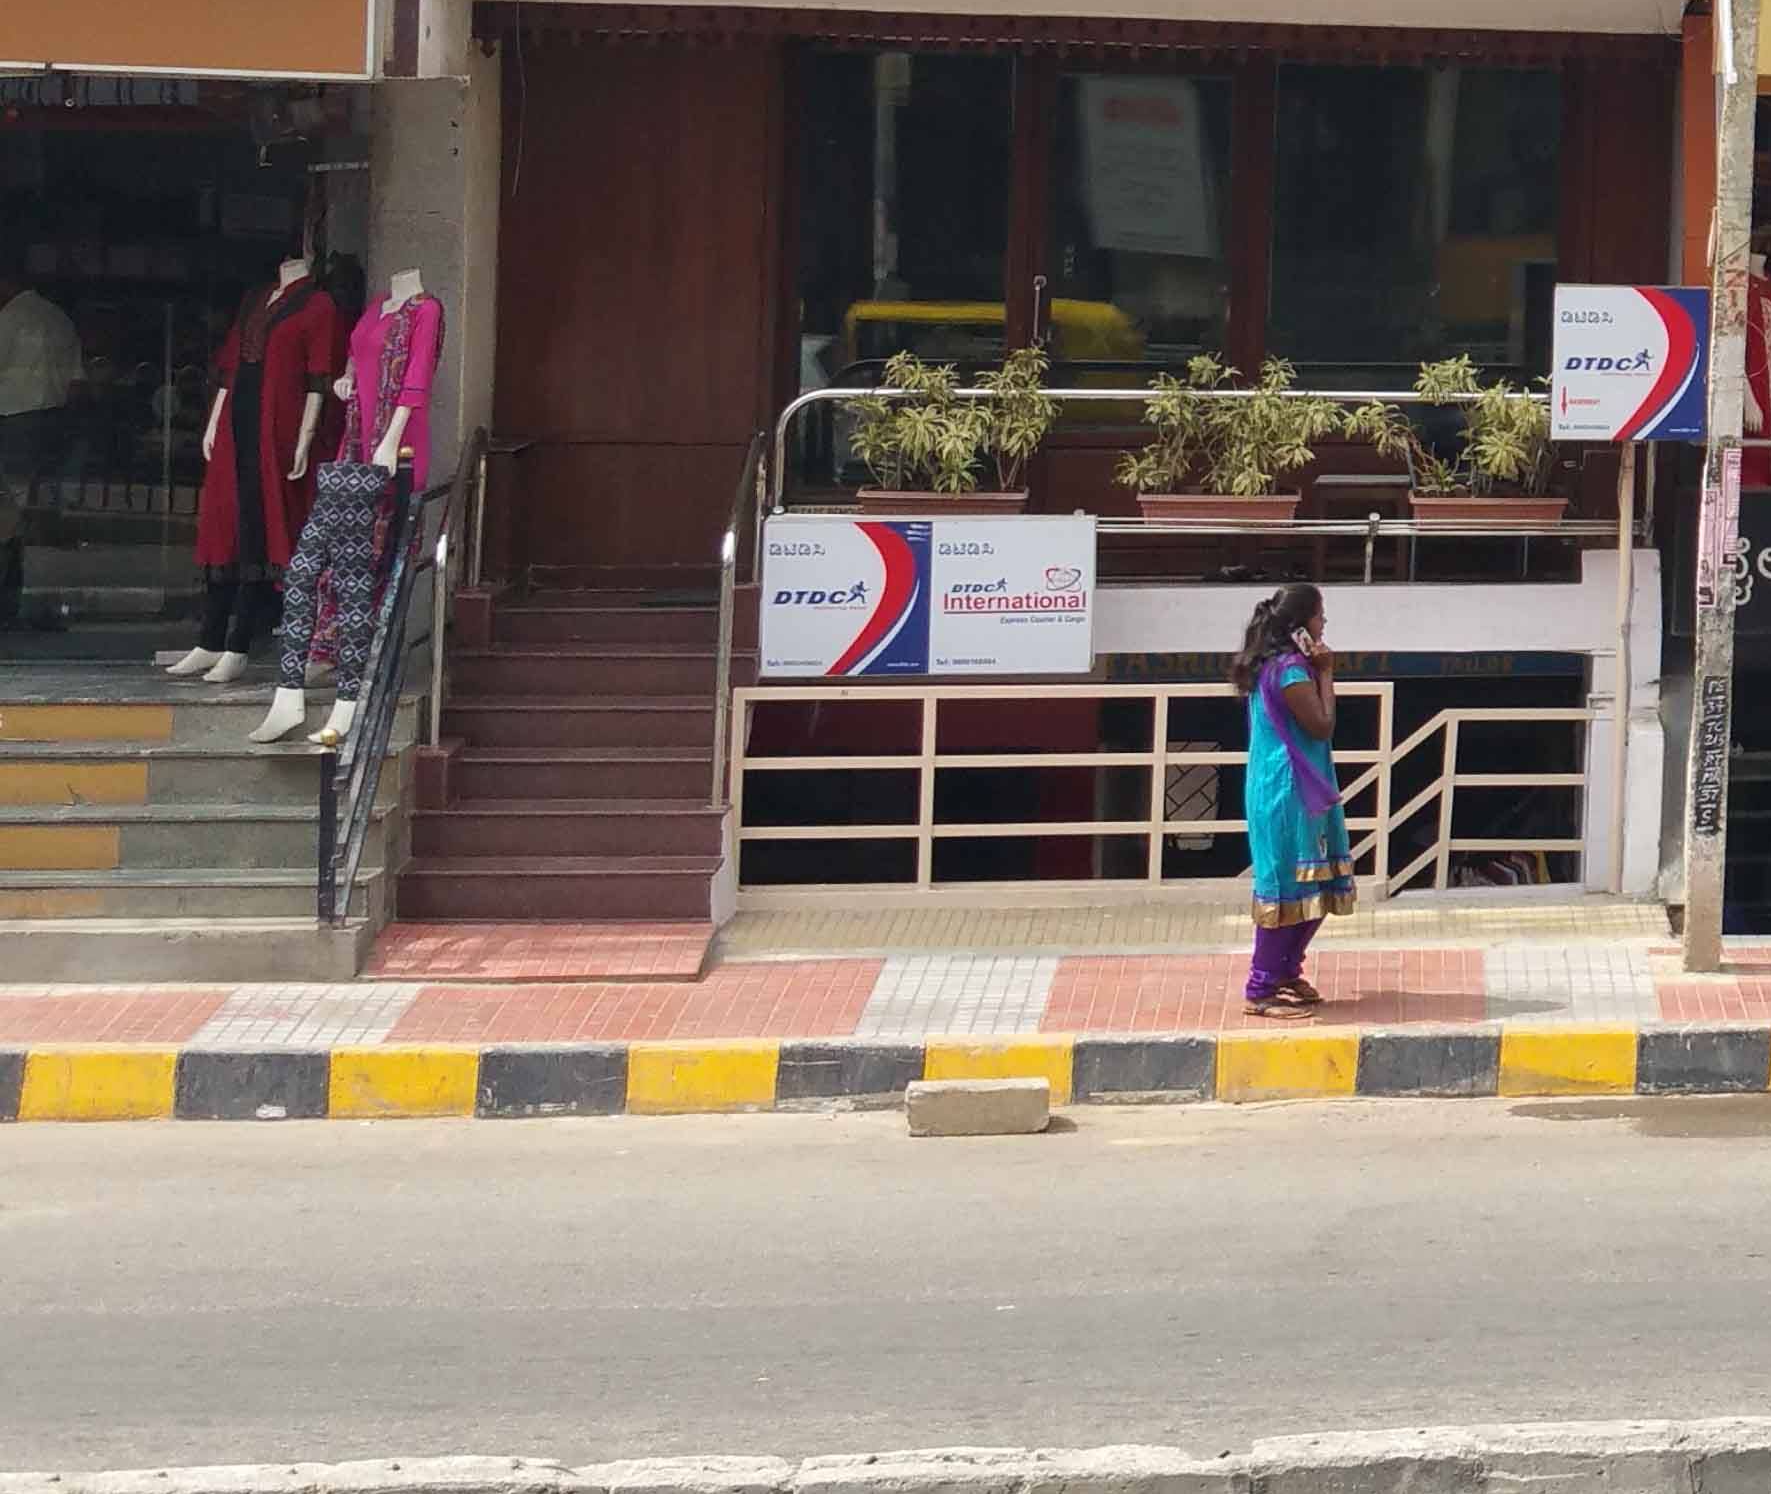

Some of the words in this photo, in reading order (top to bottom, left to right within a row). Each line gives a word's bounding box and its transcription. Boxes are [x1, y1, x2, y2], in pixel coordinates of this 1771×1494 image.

[1564, 357, 1633, 371] DTDC
[951, 585, 994, 594] DTDC
[773, 591, 847, 606] DTDC
[943, 590, 1087, 611] International
